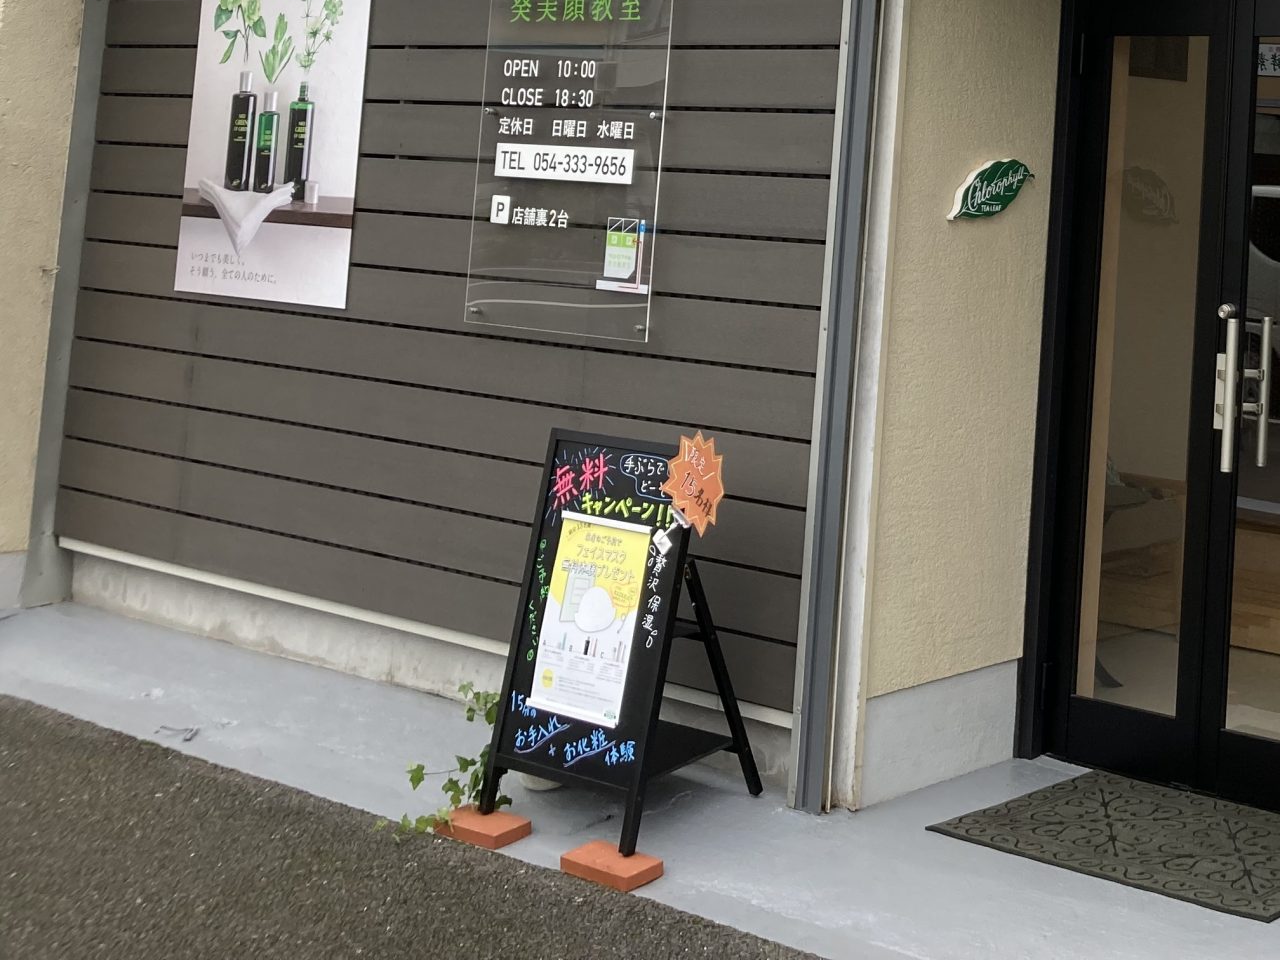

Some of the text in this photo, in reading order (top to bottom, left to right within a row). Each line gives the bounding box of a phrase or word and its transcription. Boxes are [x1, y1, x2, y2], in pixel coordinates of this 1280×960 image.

[503, 59, 596, 78] OPEN 10:00
[501, 88, 594, 107] CLOSE 18:30
[498, 117, 635, 139] 定休日 日曜日 水曜日
[501, 150, 627, 176] TEL 054-333-9656
[967, 166, 1024, 211] Chlorophyll
[511, 206, 569, 228] 店舗裏2台
[623, 455, 666, 476] 手ぶらで
[553, 453, 608, 510] 無料
[514, 715, 562, 748] お手入れ
